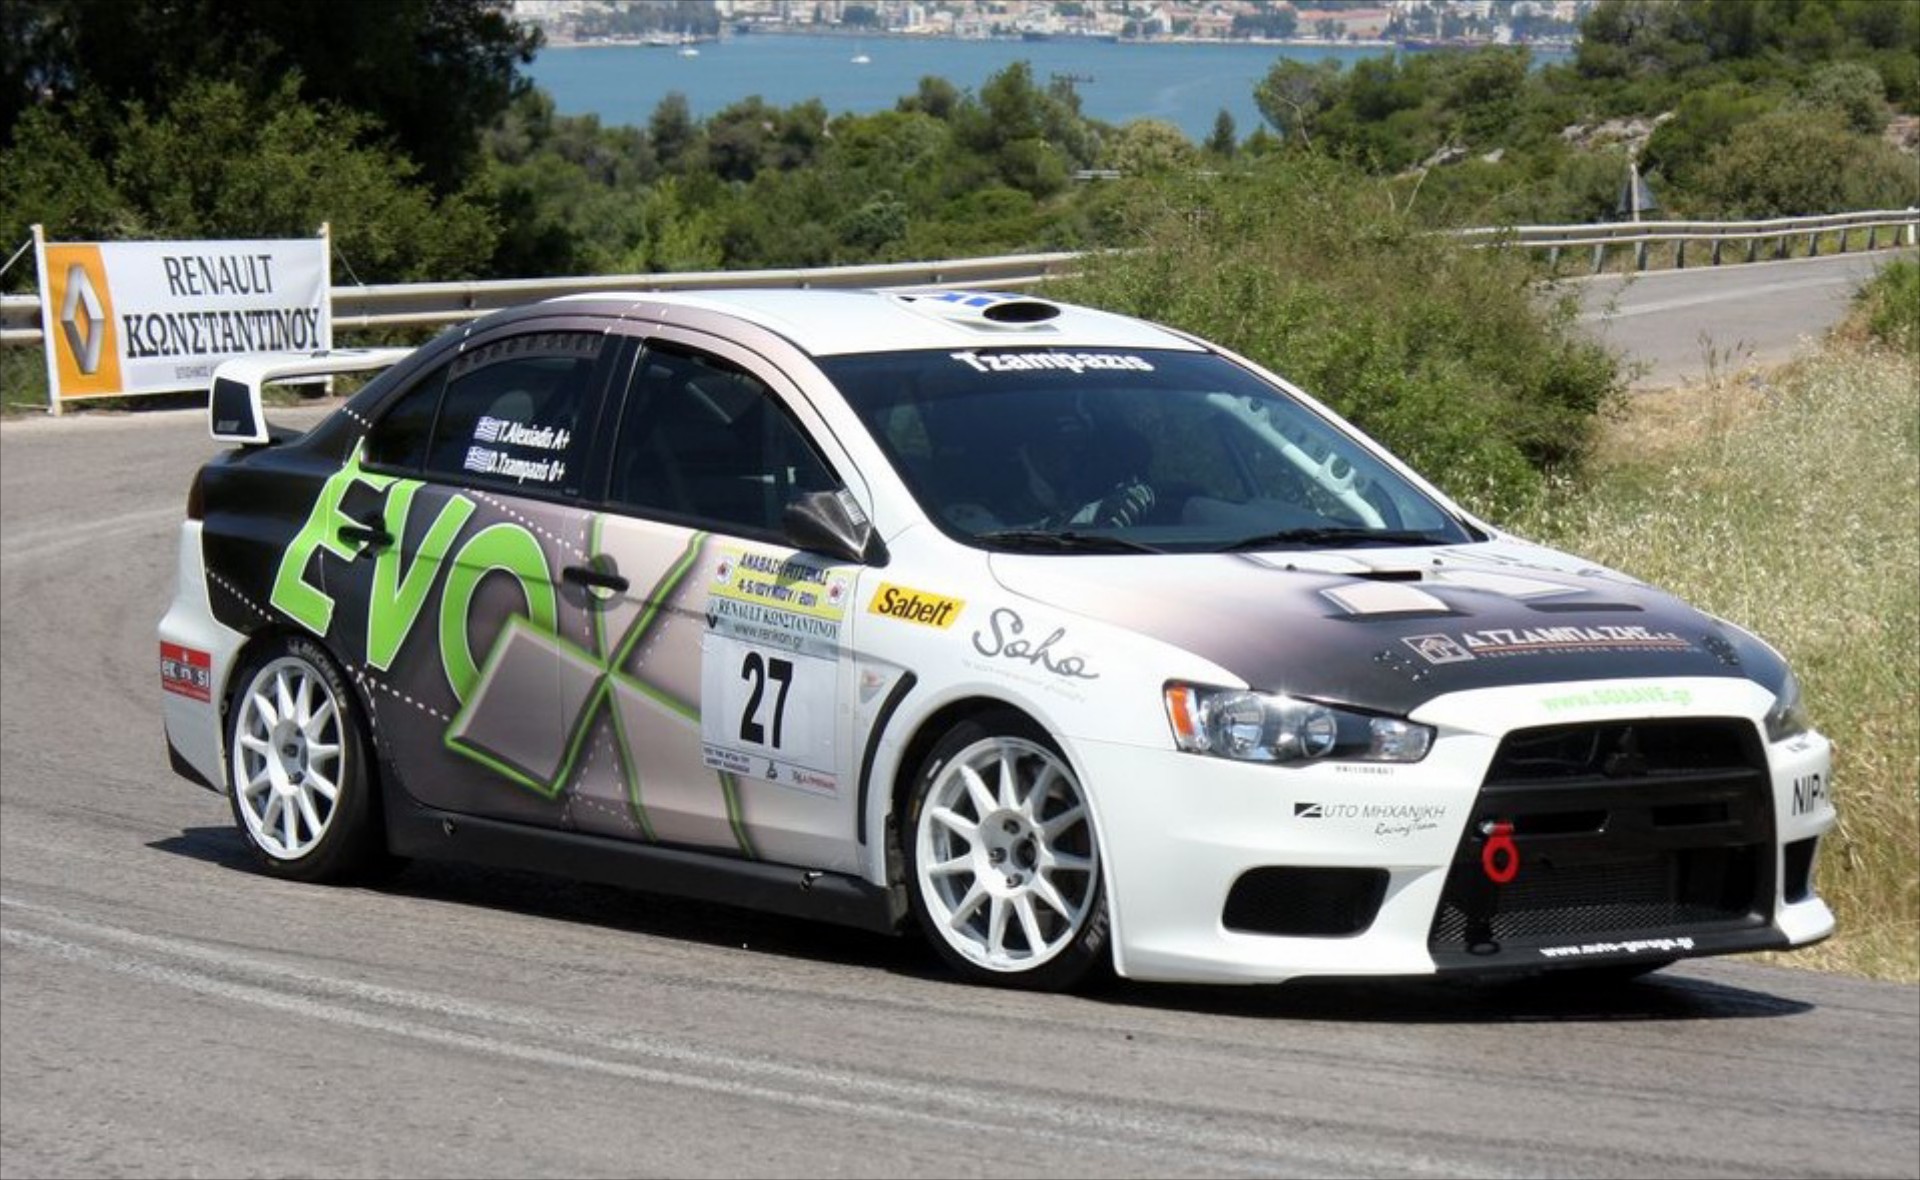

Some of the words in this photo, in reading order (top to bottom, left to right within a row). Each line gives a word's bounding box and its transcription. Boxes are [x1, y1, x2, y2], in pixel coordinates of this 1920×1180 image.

[163, 254, 272, 296] RENAULT
[122, 308, 320, 358] ΚΩΝΣΤΑΝΤΙΝΟΥ
[877, 588, 954, 626] Sabelt
[972, 607, 1100, 679] Soho
[740, 651, 794, 750] 27
